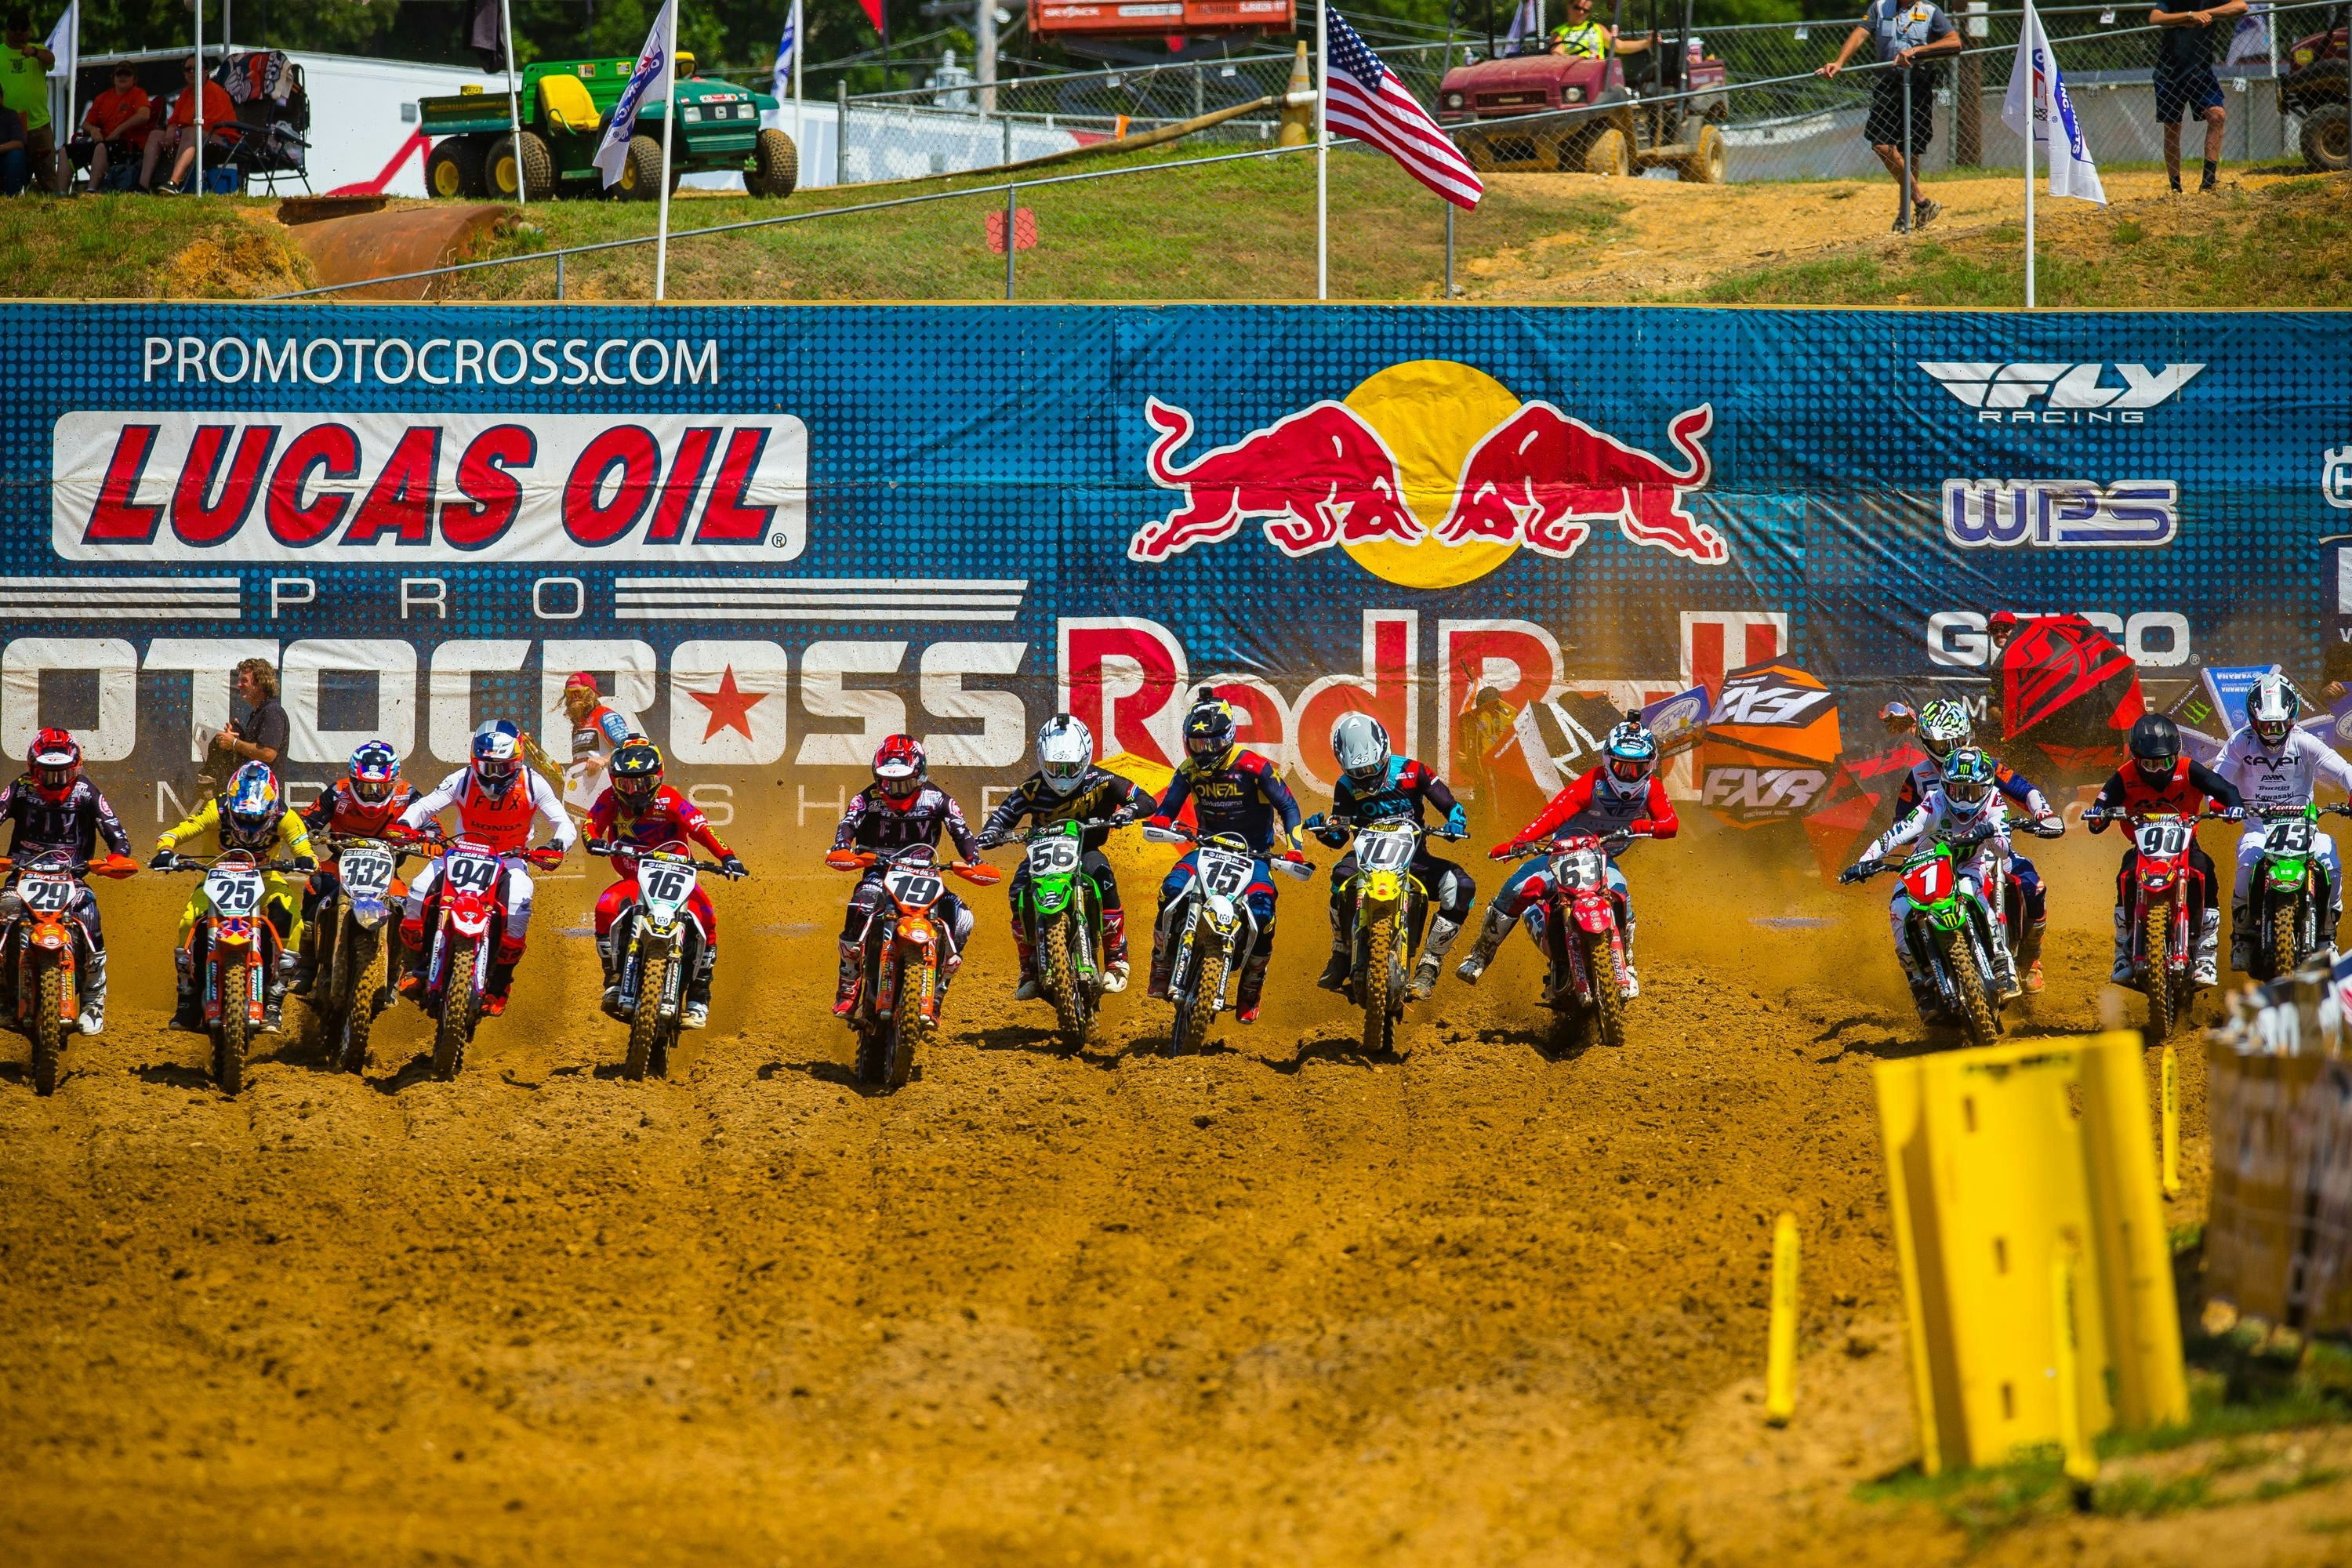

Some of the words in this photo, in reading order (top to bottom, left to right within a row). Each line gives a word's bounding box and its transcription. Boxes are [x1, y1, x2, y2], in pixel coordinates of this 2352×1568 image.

[144, 337, 719, 386] PROMOTOCROSS.COM
[1978, 410, 2144, 424] RACING
[82, 423, 538, 551] LUCAS
[562, 424, 778, 547] OIL
[1943, 479, 2178, 547] WPS
[270, 577, 586, 619] PRO
[474, 795, 521, 811] FOX
[1701, 768, 1828, 808] FXR
[2256, 792, 2295, 801] Kawasaki
[470, 821, 522, 832] HONDA
[2143, 827, 2185, 855] 90
[2264, 824, 2313, 852] 43
[1032, 842, 1075, 872] 56
[1359, 838, 1414, 867] 101
[343, 857, 392, 889] 332
[452, 858, 496, 891] 94
[648, 870, 686, 901] 16
[1206, 861, 1245, 894] 15
[1559, 855, 1600, 888] 63
[1919, 865, 1938, 896] 1
[27, 882, 71, 910] 29
[216, 880, 256, 909] 25
[891, 875, 940, 905] 19
[1219, 956, 1230, 996] DUNLOP
[1610, 948, 1625, 982] VERTEX
[670, 963, 679, 1002] DUNLOP
